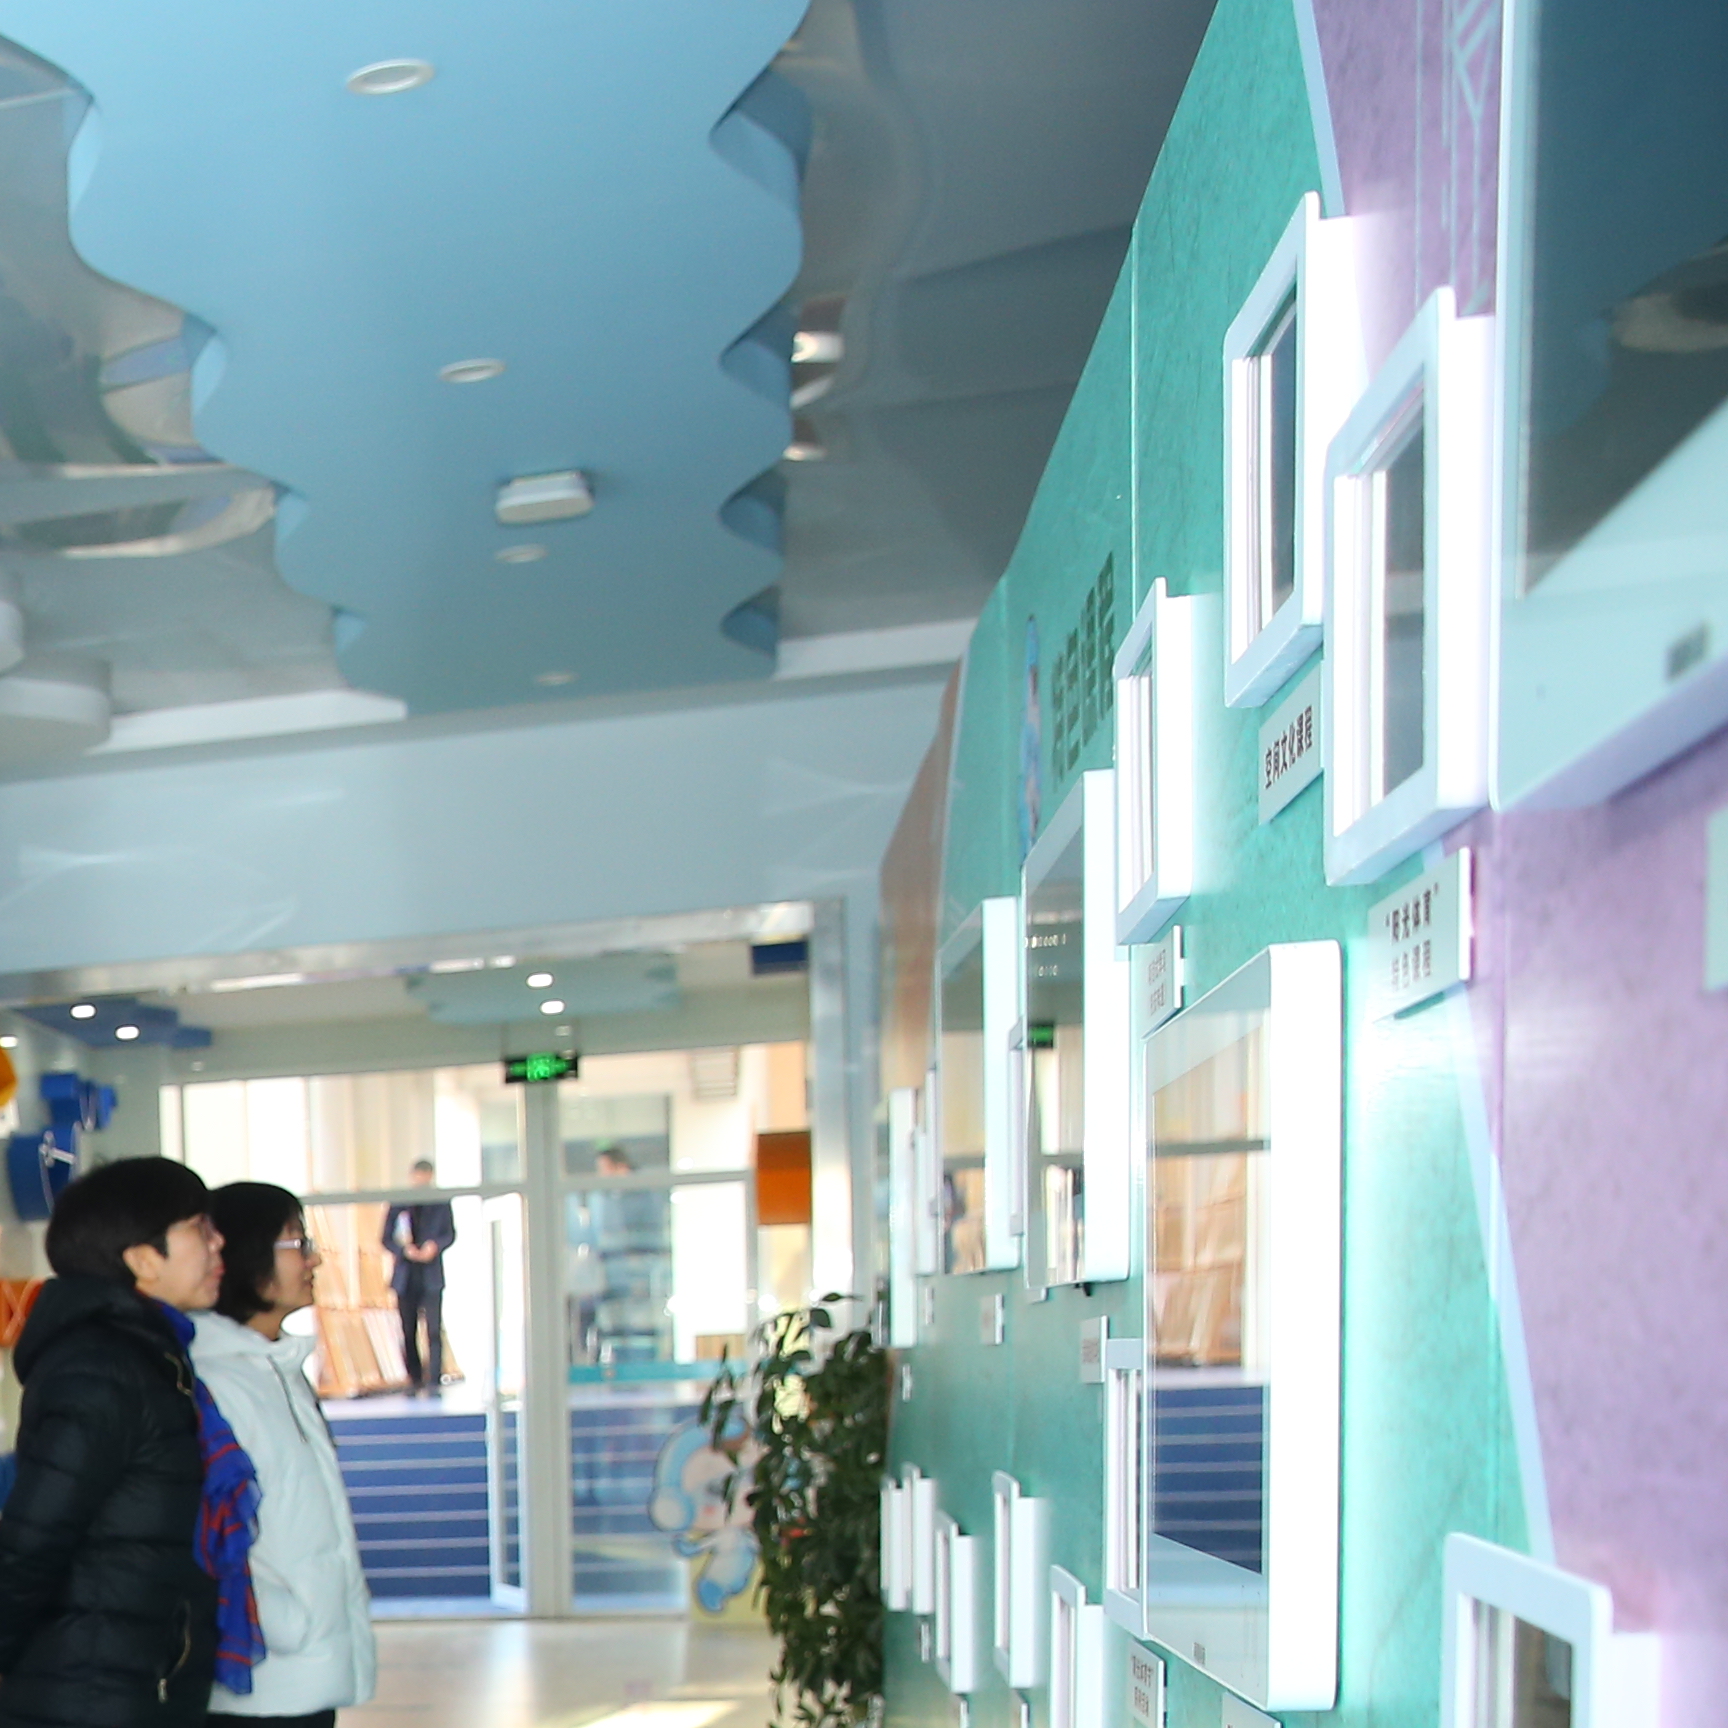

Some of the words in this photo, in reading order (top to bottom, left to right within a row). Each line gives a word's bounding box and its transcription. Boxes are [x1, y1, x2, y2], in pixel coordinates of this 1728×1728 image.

[1051, 551, 1114, 792] 特色课程
[1265, 705, 1313, 789] 空间文化课程
